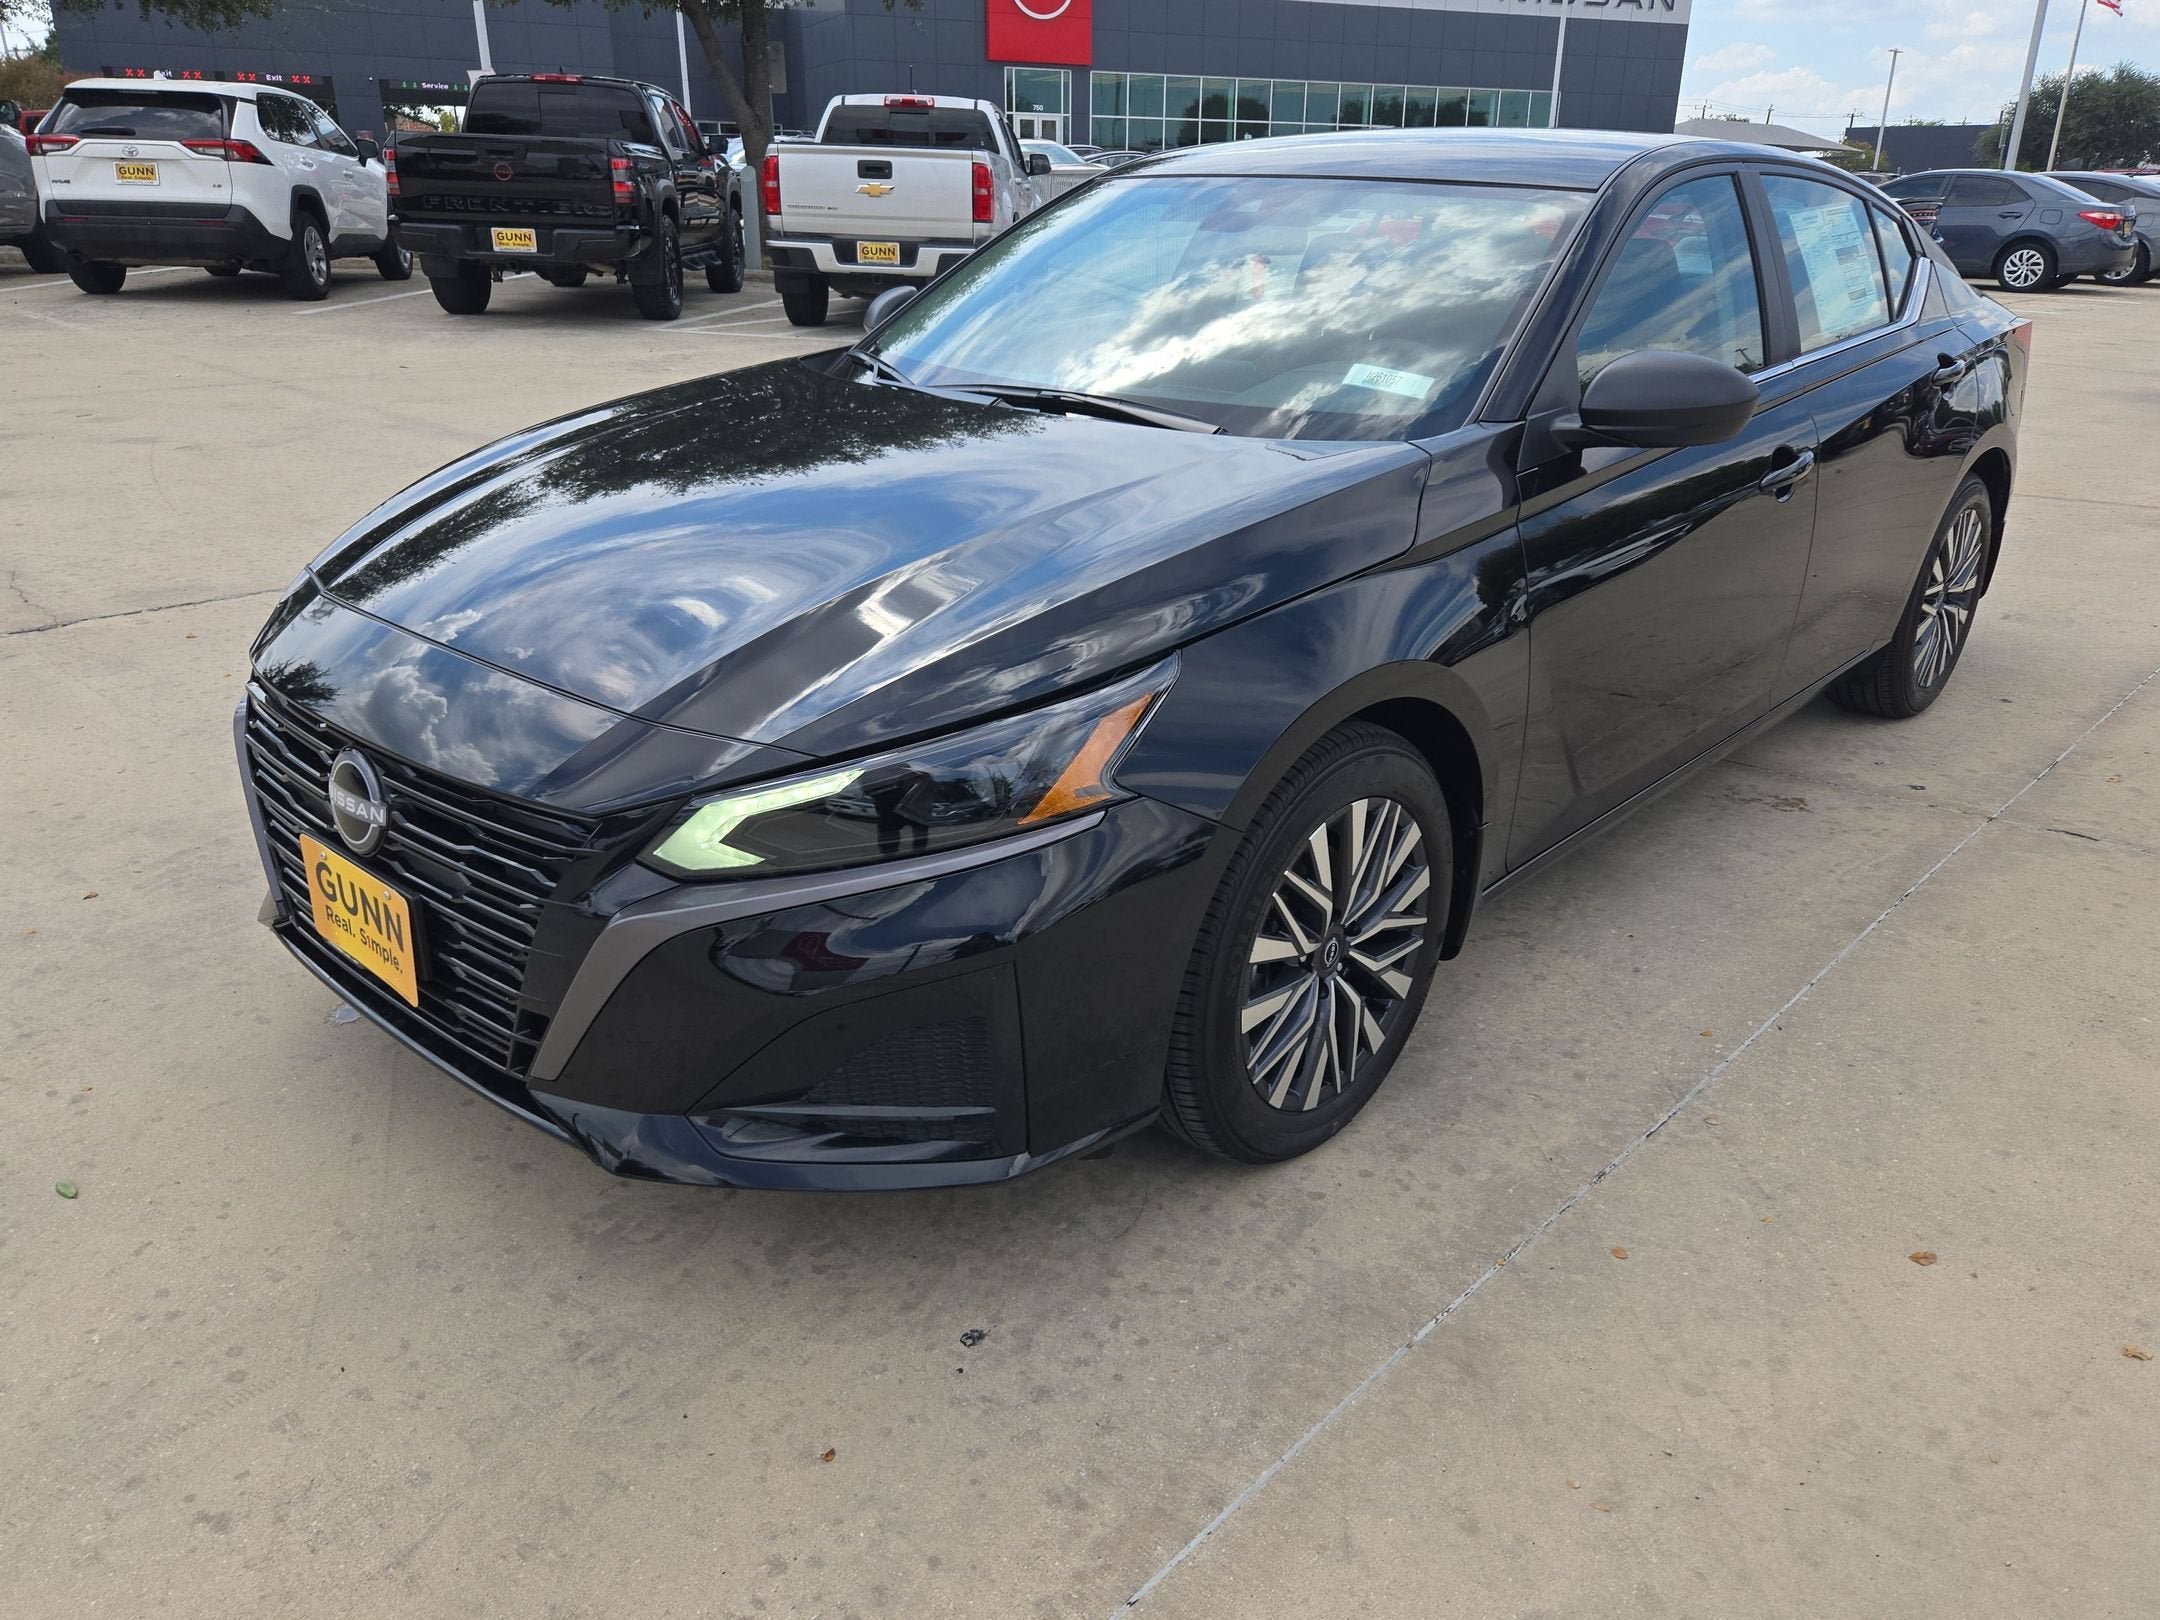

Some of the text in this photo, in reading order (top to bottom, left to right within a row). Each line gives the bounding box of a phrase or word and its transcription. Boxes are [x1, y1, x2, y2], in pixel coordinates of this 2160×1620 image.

[265, 74, 283, 82] Exit
[421, 82, 448, 90] Service
[118, 166, 155, 176] GUNN
[496, 232, 532, 242] GUNN
[861, 246, 896, 257] GUNN
[329, 783, 384, 824] NISSAN
[315, 861, 405, 954] GUNN
[325, 904, 404, 975] Real. Simple.
